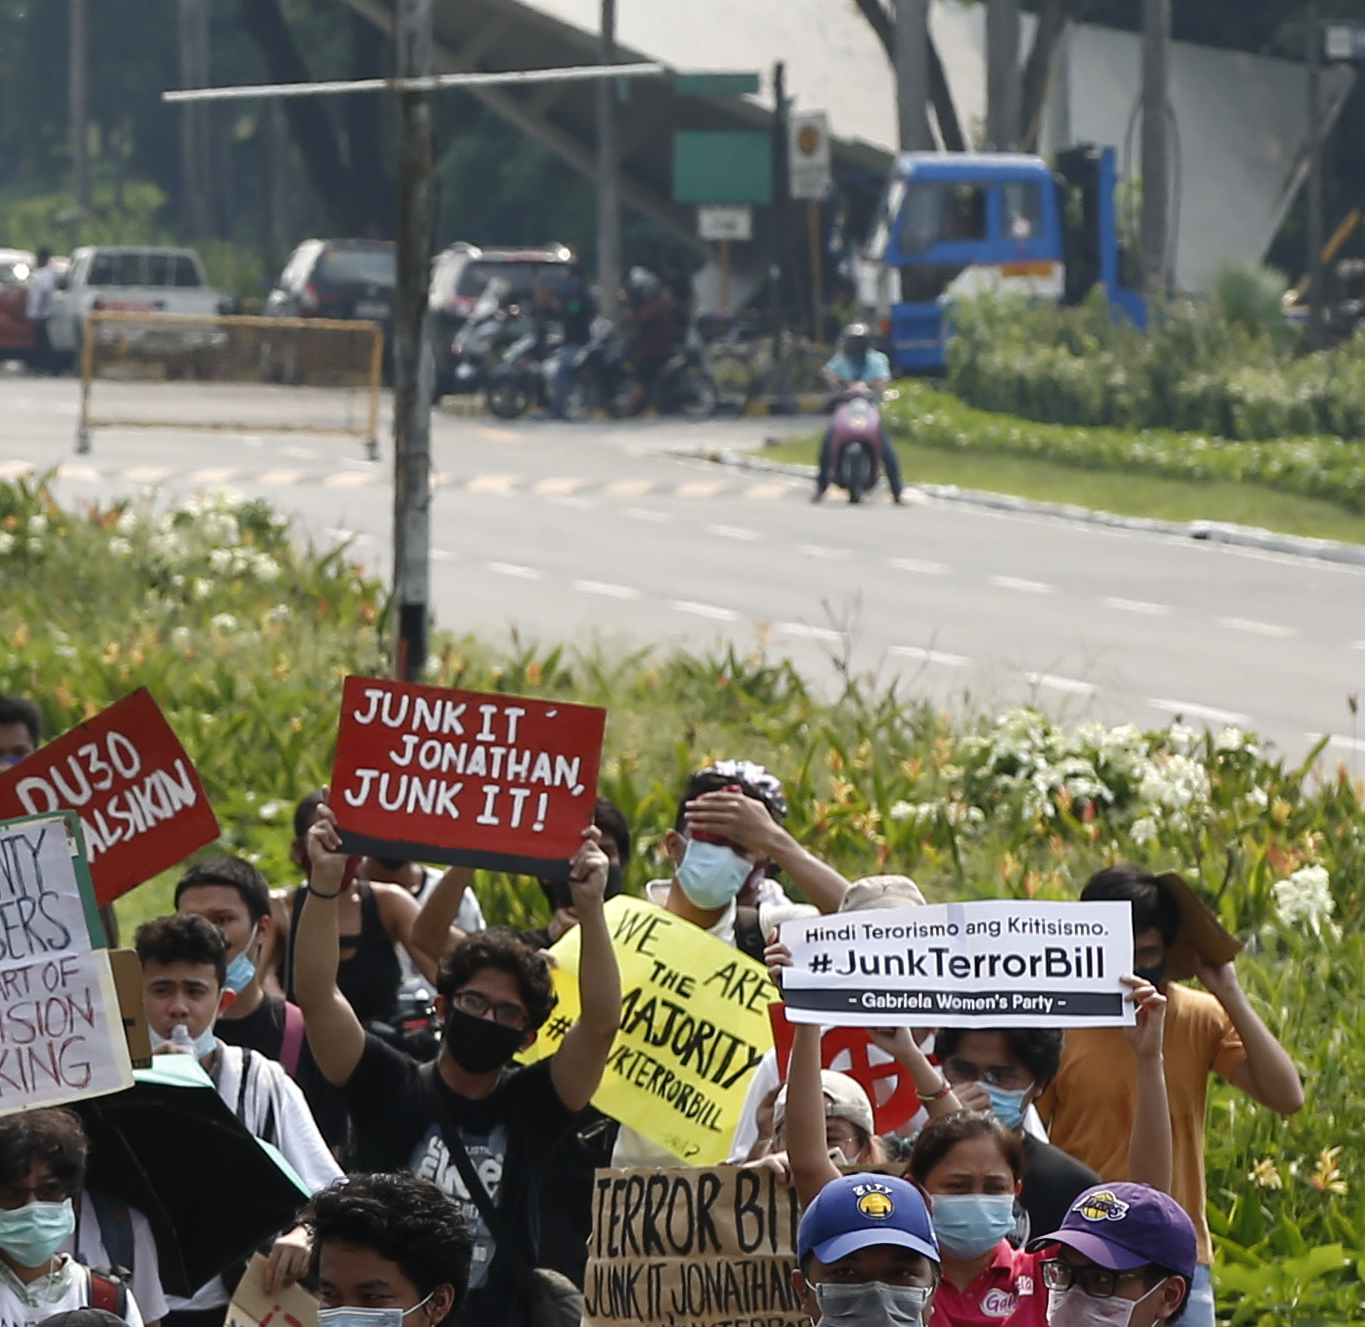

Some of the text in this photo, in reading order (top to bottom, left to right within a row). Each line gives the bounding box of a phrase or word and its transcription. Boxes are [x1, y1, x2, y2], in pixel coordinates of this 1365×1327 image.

[352, 688, 526, 743] JUNK IT
[15, 730, 141, 816] DU30
[389, 733, 585, 799] JONATHAN,
[78, 757, 199, 864] ALSIKIN
[344, 767, 549, 832] JUNK IT!
[805, 916, 1110, 943] Hindi Terorismo ang Kritisismo.
[40, 955, 80, 993] OF
[612, 908, 776, 1016] WE ARE
[649, 960, 697, 1000] THE
[808, 946, 1105, 980] #JunkTerrorBill
[861, 992, 1054, 1014] Gabriela Women's Party
[596, 1172, 724, 1260] TERROR
[735, 1168, 801, 1255] BI
[583, 1260, 646, 1322] JUNK
